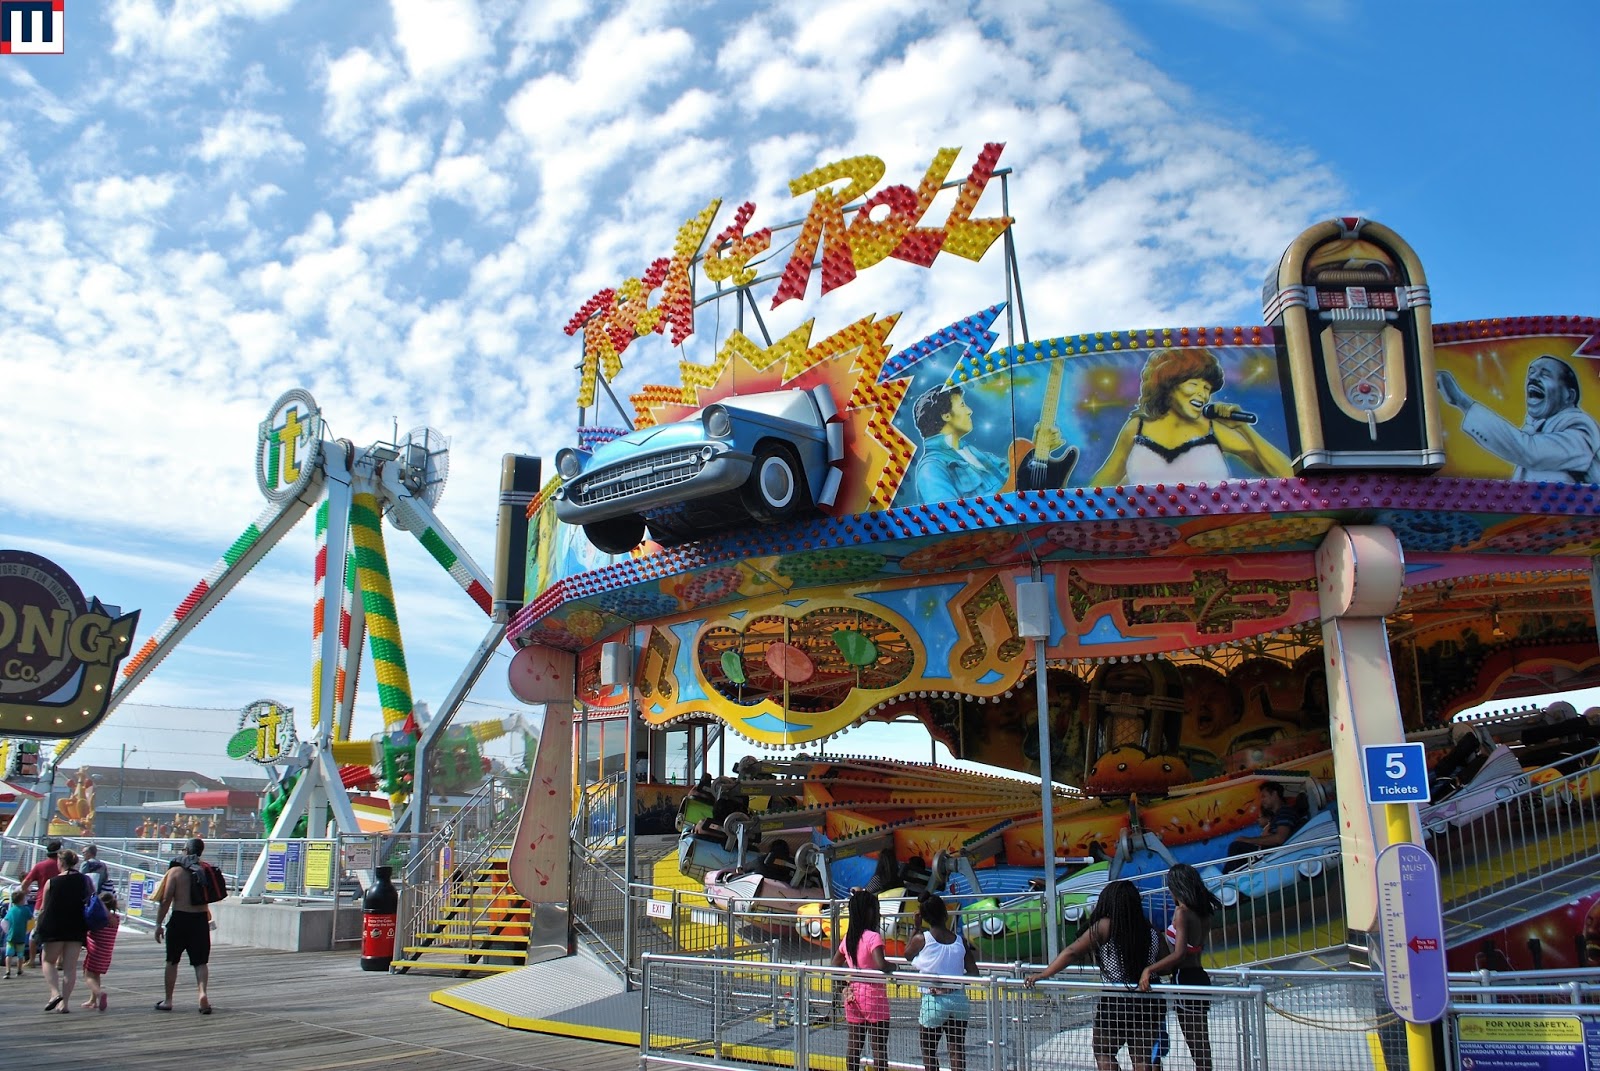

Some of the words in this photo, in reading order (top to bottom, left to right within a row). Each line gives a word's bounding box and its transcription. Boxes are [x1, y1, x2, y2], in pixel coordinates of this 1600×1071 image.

[20, 566, 31, 576] OF
[33, 570, 48, 584] FUN
[48, 580, 69, 605] THINGS
[5, 658, 39, 681] Co.
[1385, 752, 1406, 779] 5
[1378, 785, 1418, 795] Tickets
[1401, 863, 1427, 872] MUST
[652, 903, 665, 914] EXIT
[1485, 1020, 1504, 1028] FOR
[1506, 1020, 1531, 1028] YOUR
